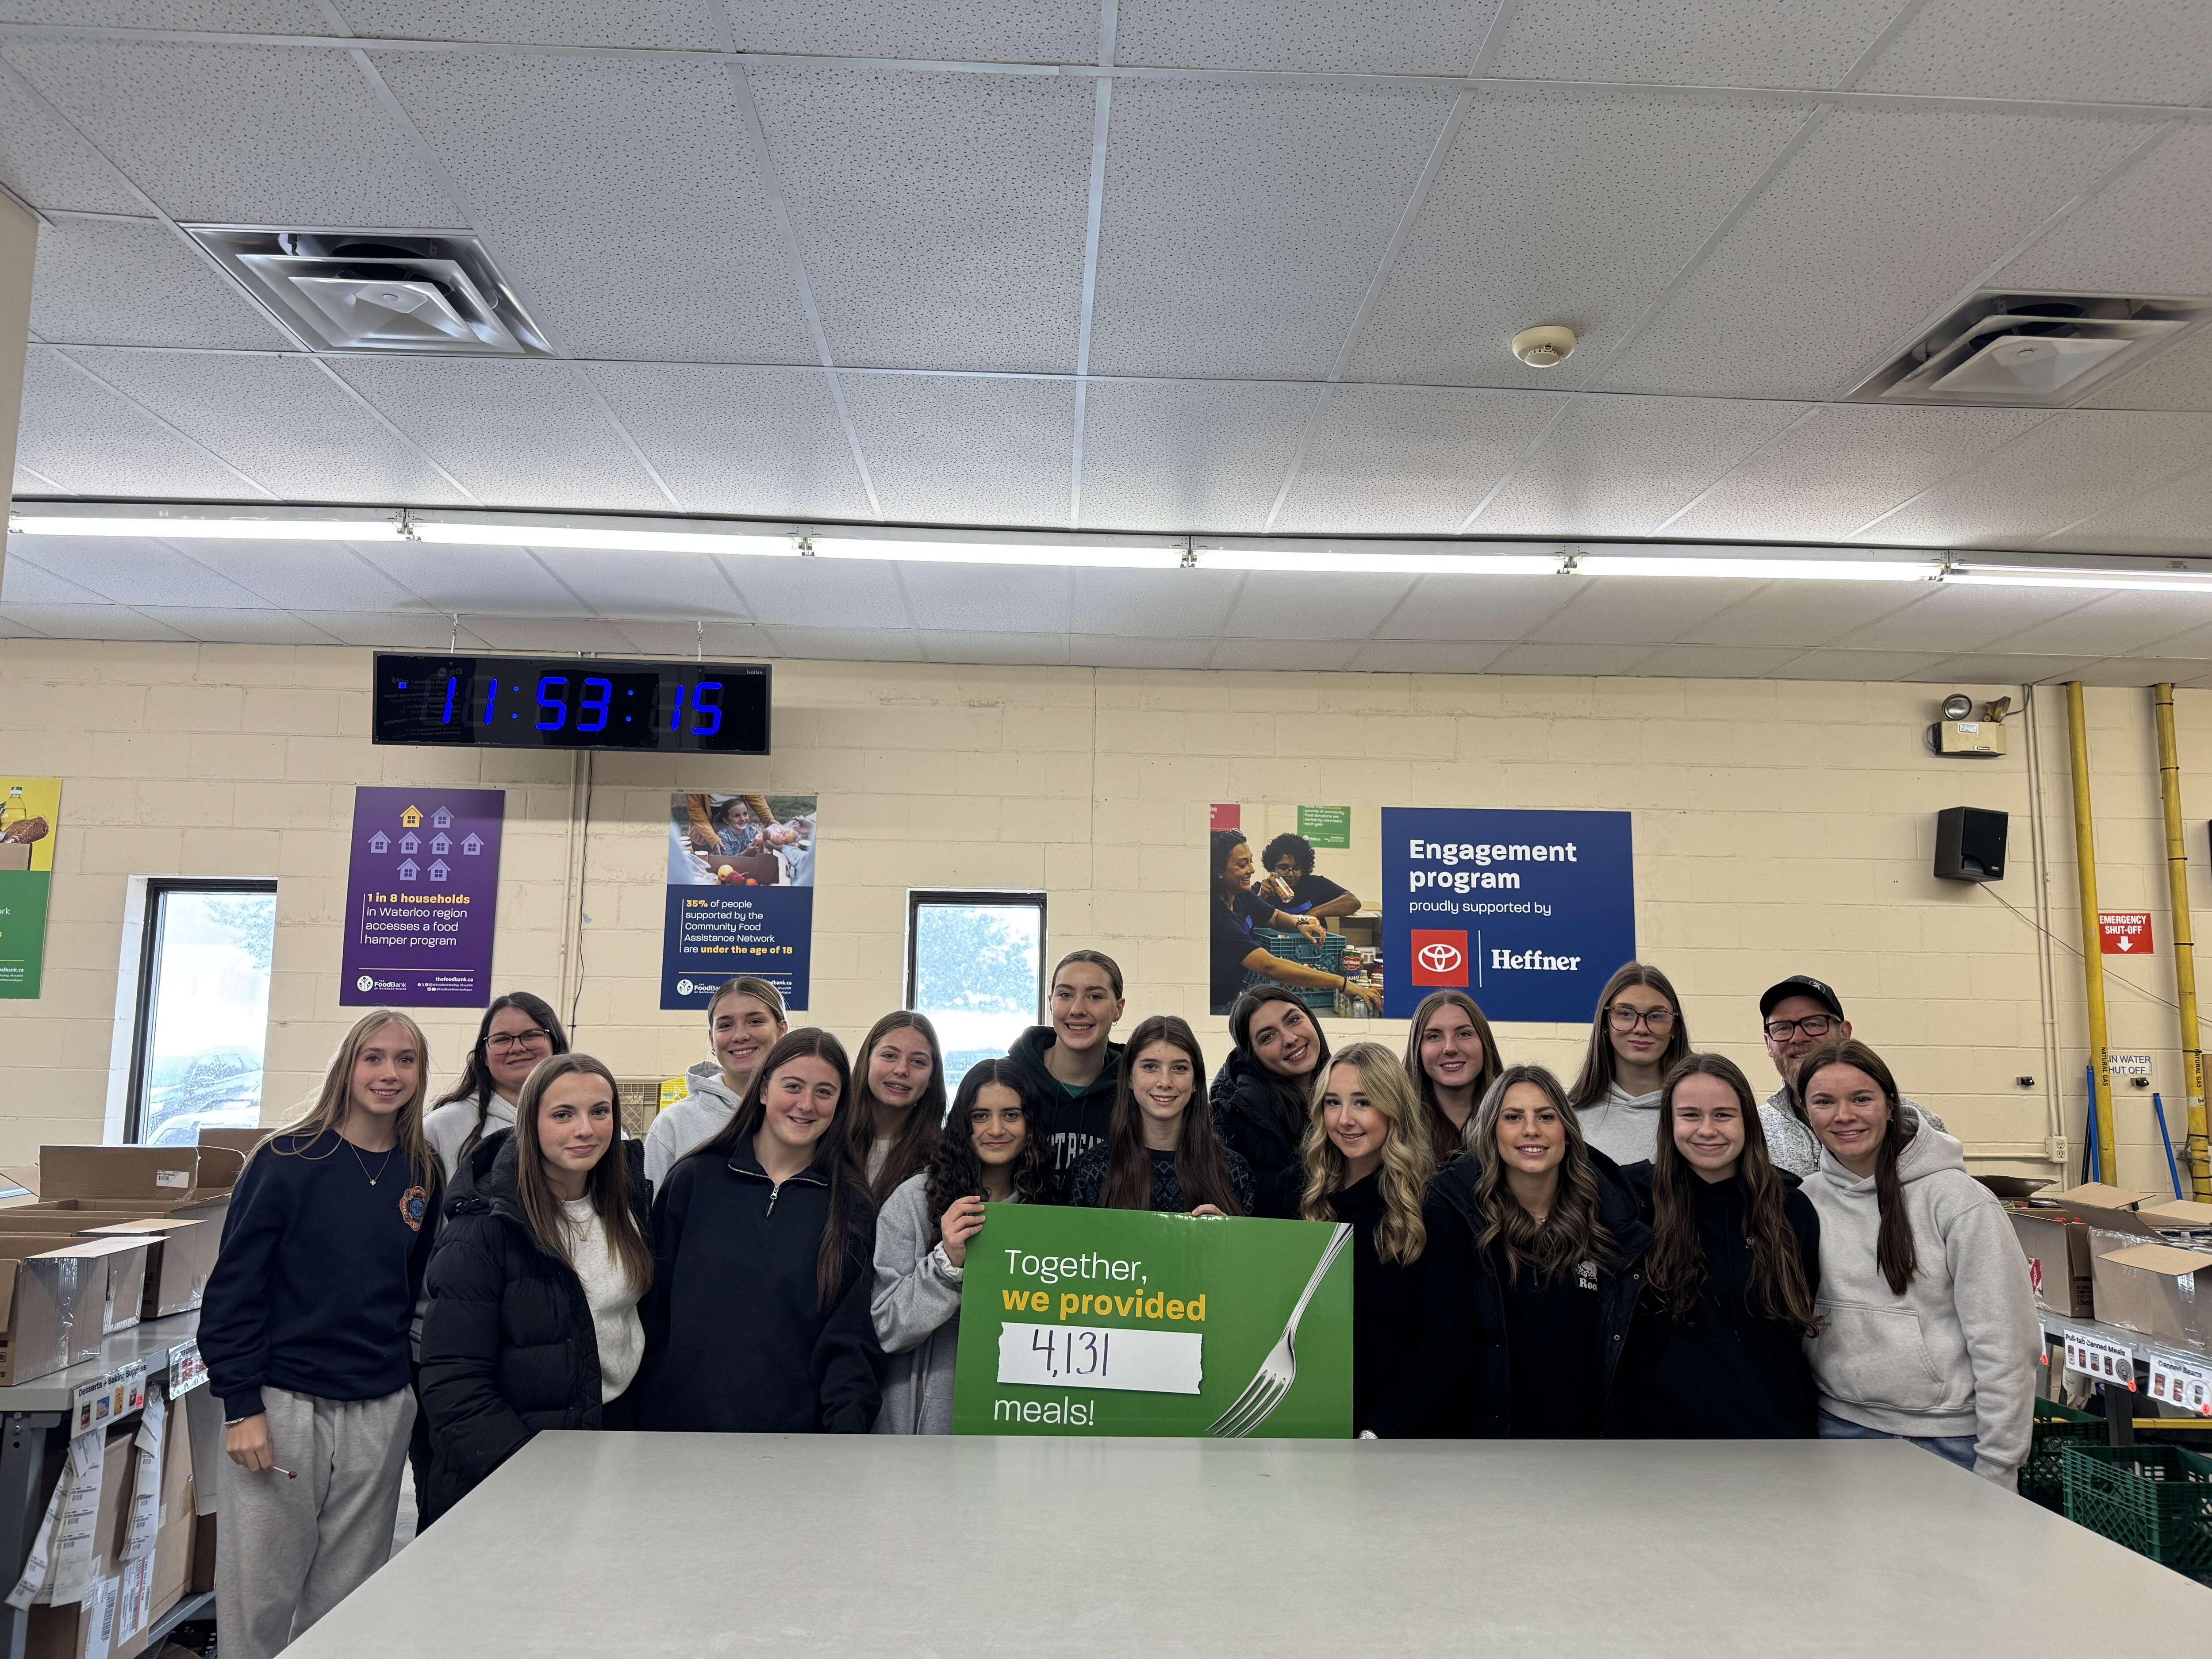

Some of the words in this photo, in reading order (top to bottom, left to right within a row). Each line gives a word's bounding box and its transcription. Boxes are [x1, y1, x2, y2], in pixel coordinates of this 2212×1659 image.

[1410, 839, 1577, 866] Engagement
[1410, 871, 1520, 894] program
[368, 893, 372, 902] 1
[376, 892, 386, 902] in
[390, 894, 397, 902] 8
[401, 894, 470, 904] households
[722, 900, 752, 909] people
[367, 907, 376, 916] in
[380, 907, 430, 918] Waterloo
[433, 908, 467, 920] region
[1409, 900, 1459, 914] proudly
[1462, 902, 1531, 915] supported
[1534, 902, 1551, 916] by
[686, 912, 732, 920] supported
[734, 912, 746, 921] by
[2099, 915, 2147, 924] EMERGENCY
[365, 922, 419, 931] accesses
[433, 922, 458, 931] food
[685, 923, 736, 932] Community
[2105, 926, 2142, 934] SHUT-OFF
[365, 935, 407, 947] hamper
[410, 937, 457, 948] program
[1491, 949, 1581, 971] Heffner
[1005, 1249, 1148, 1285] Together,
[1579, 1277, 1598, 1291] Roo
[1002, 1289, 1049, 1313] we
[1060, 1289, 1206, 1321] provided
[2066, 1334, 2085, 1344] Pull-tab
[2086, 1340, 2107, 1351] Canned
[2108, 1346, 2126, 1356] Meals
[1032, 1328, 1109, 1378] 4,131
[79, 1381, 103, 1397] Desserts
[108, 1373, 125, 1385] Baking
[994, 1395, 1094, 1426] meals!
